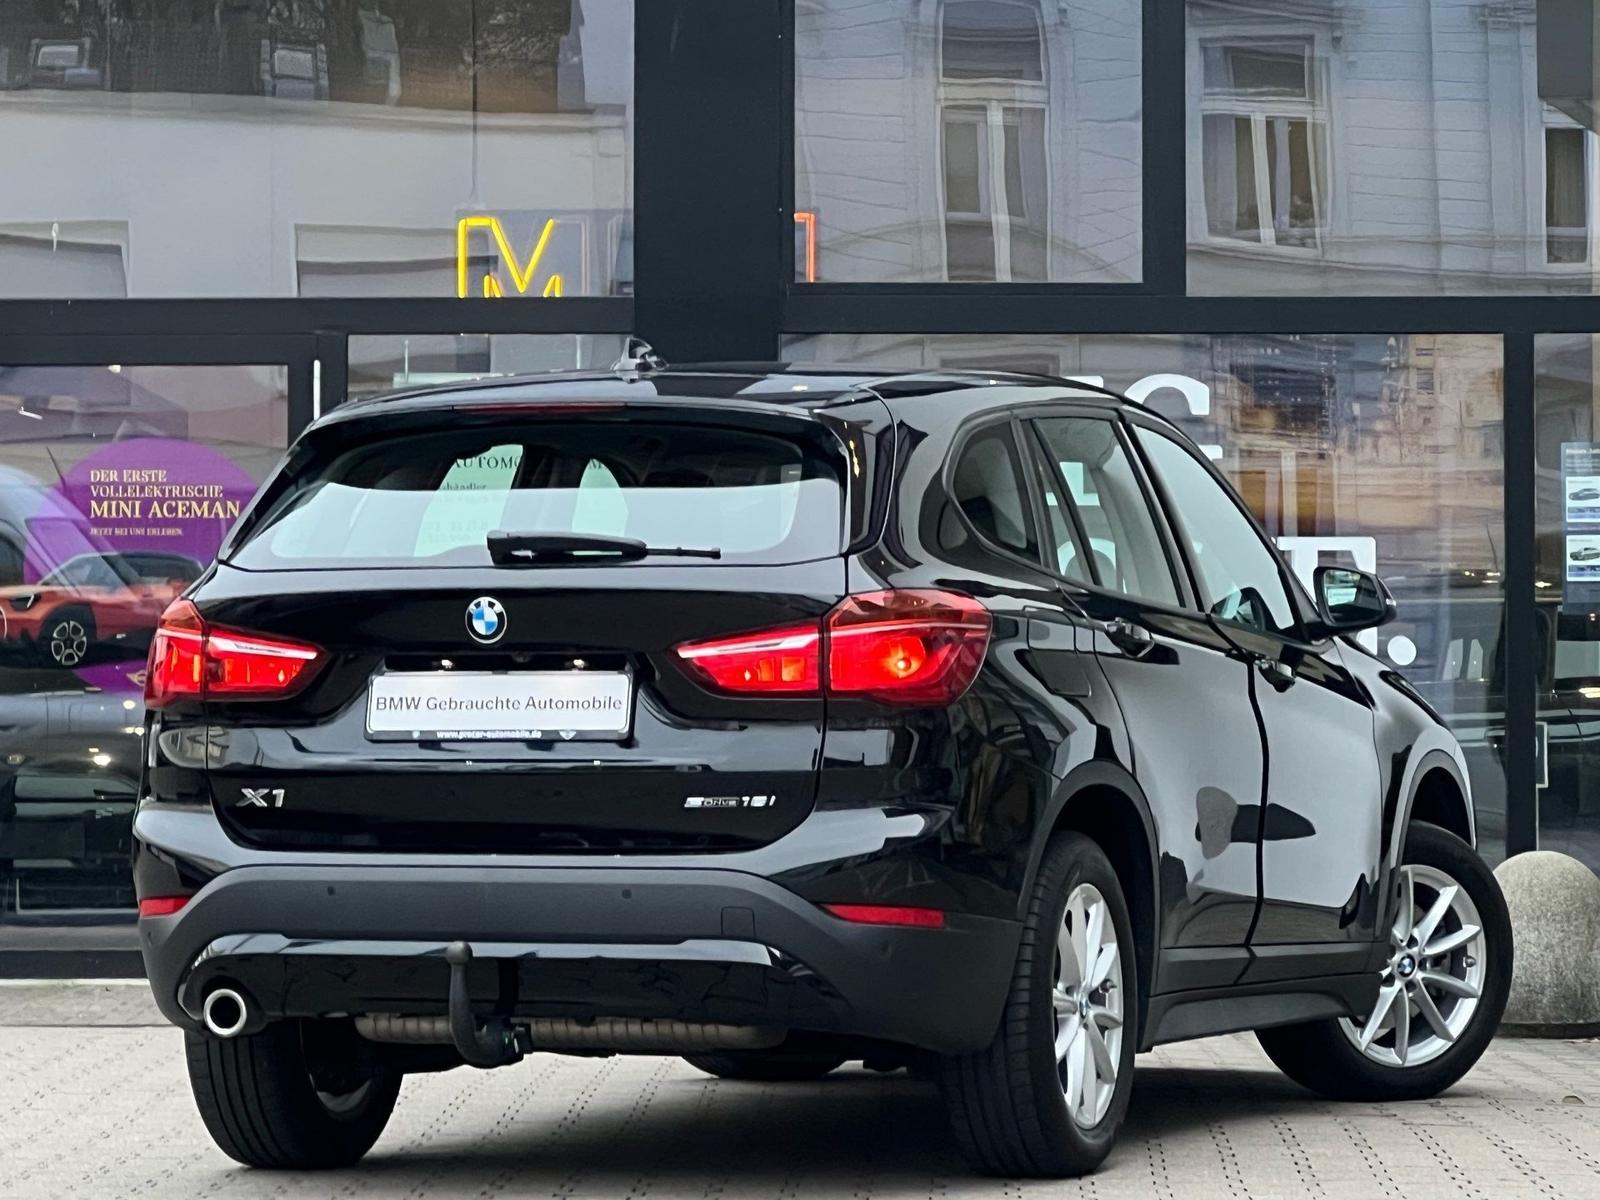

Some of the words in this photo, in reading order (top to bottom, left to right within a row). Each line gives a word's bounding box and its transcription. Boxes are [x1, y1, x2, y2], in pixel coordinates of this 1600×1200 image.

[90, 469, 118, 483] DER
[123, 469, 167, 483] ERSTE
[90, 485, 223, 498] VOLLELEKTRISCHE
[90, 500, 142, 519] MINI
[148, 500, 240, 519] ACEMAN
[375, 696, 421, 711] BMW
[426, 695, 521, 711] Gebrauchte
[525, 695, 622, 711] Automobile
[235, 788, 285, 808] X1
